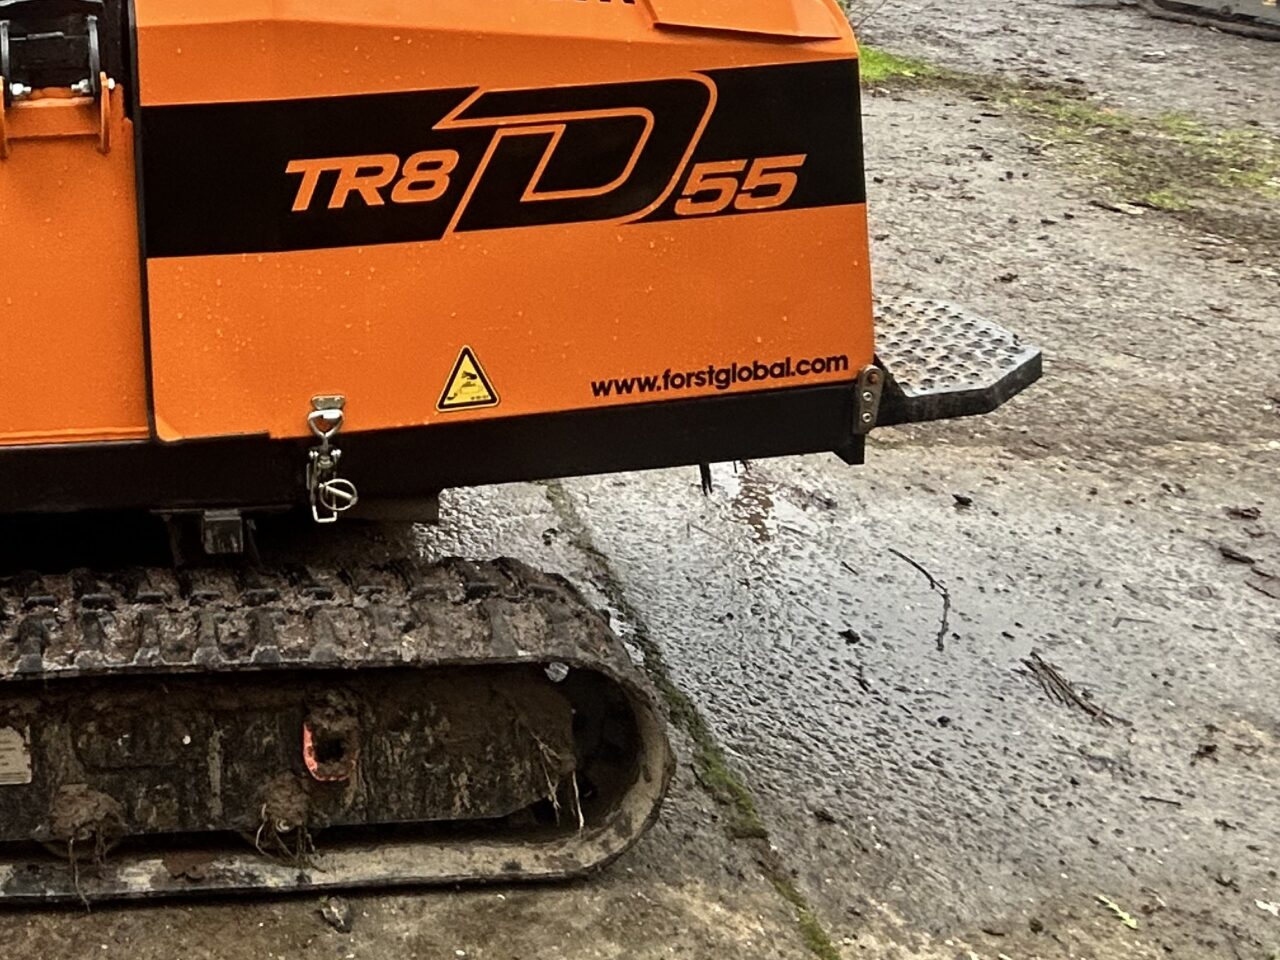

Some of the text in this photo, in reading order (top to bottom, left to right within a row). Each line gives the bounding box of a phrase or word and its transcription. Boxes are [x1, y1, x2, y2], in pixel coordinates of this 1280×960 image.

[285, 148, 460, 212] TR8
[674, 153, 807, 216] 55
[590, 354, 849, 398] www.forstglobal.com
